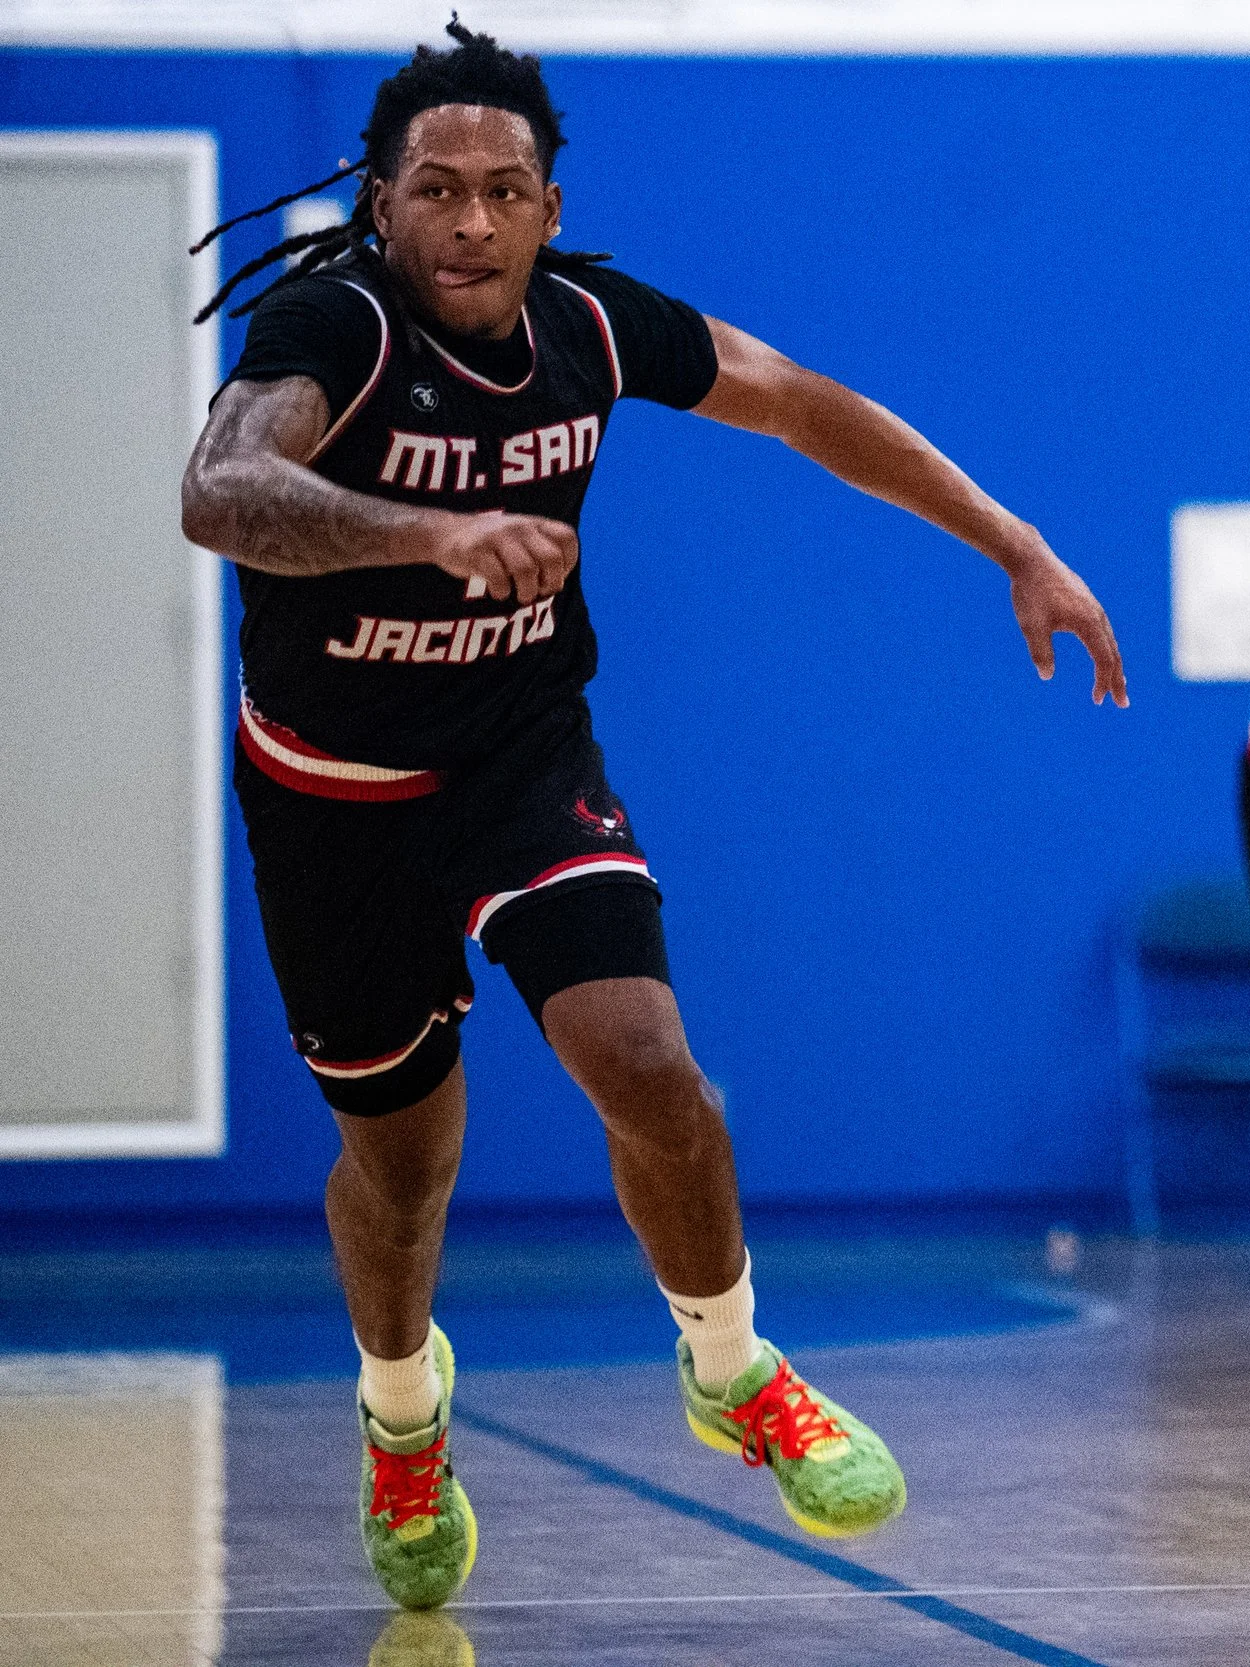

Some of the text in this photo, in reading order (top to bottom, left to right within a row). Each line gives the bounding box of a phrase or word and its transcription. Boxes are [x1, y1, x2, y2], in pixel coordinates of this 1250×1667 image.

[380, 415, 600, 491] MT. SAN
[326, 595, 556, 662] JACINTO
